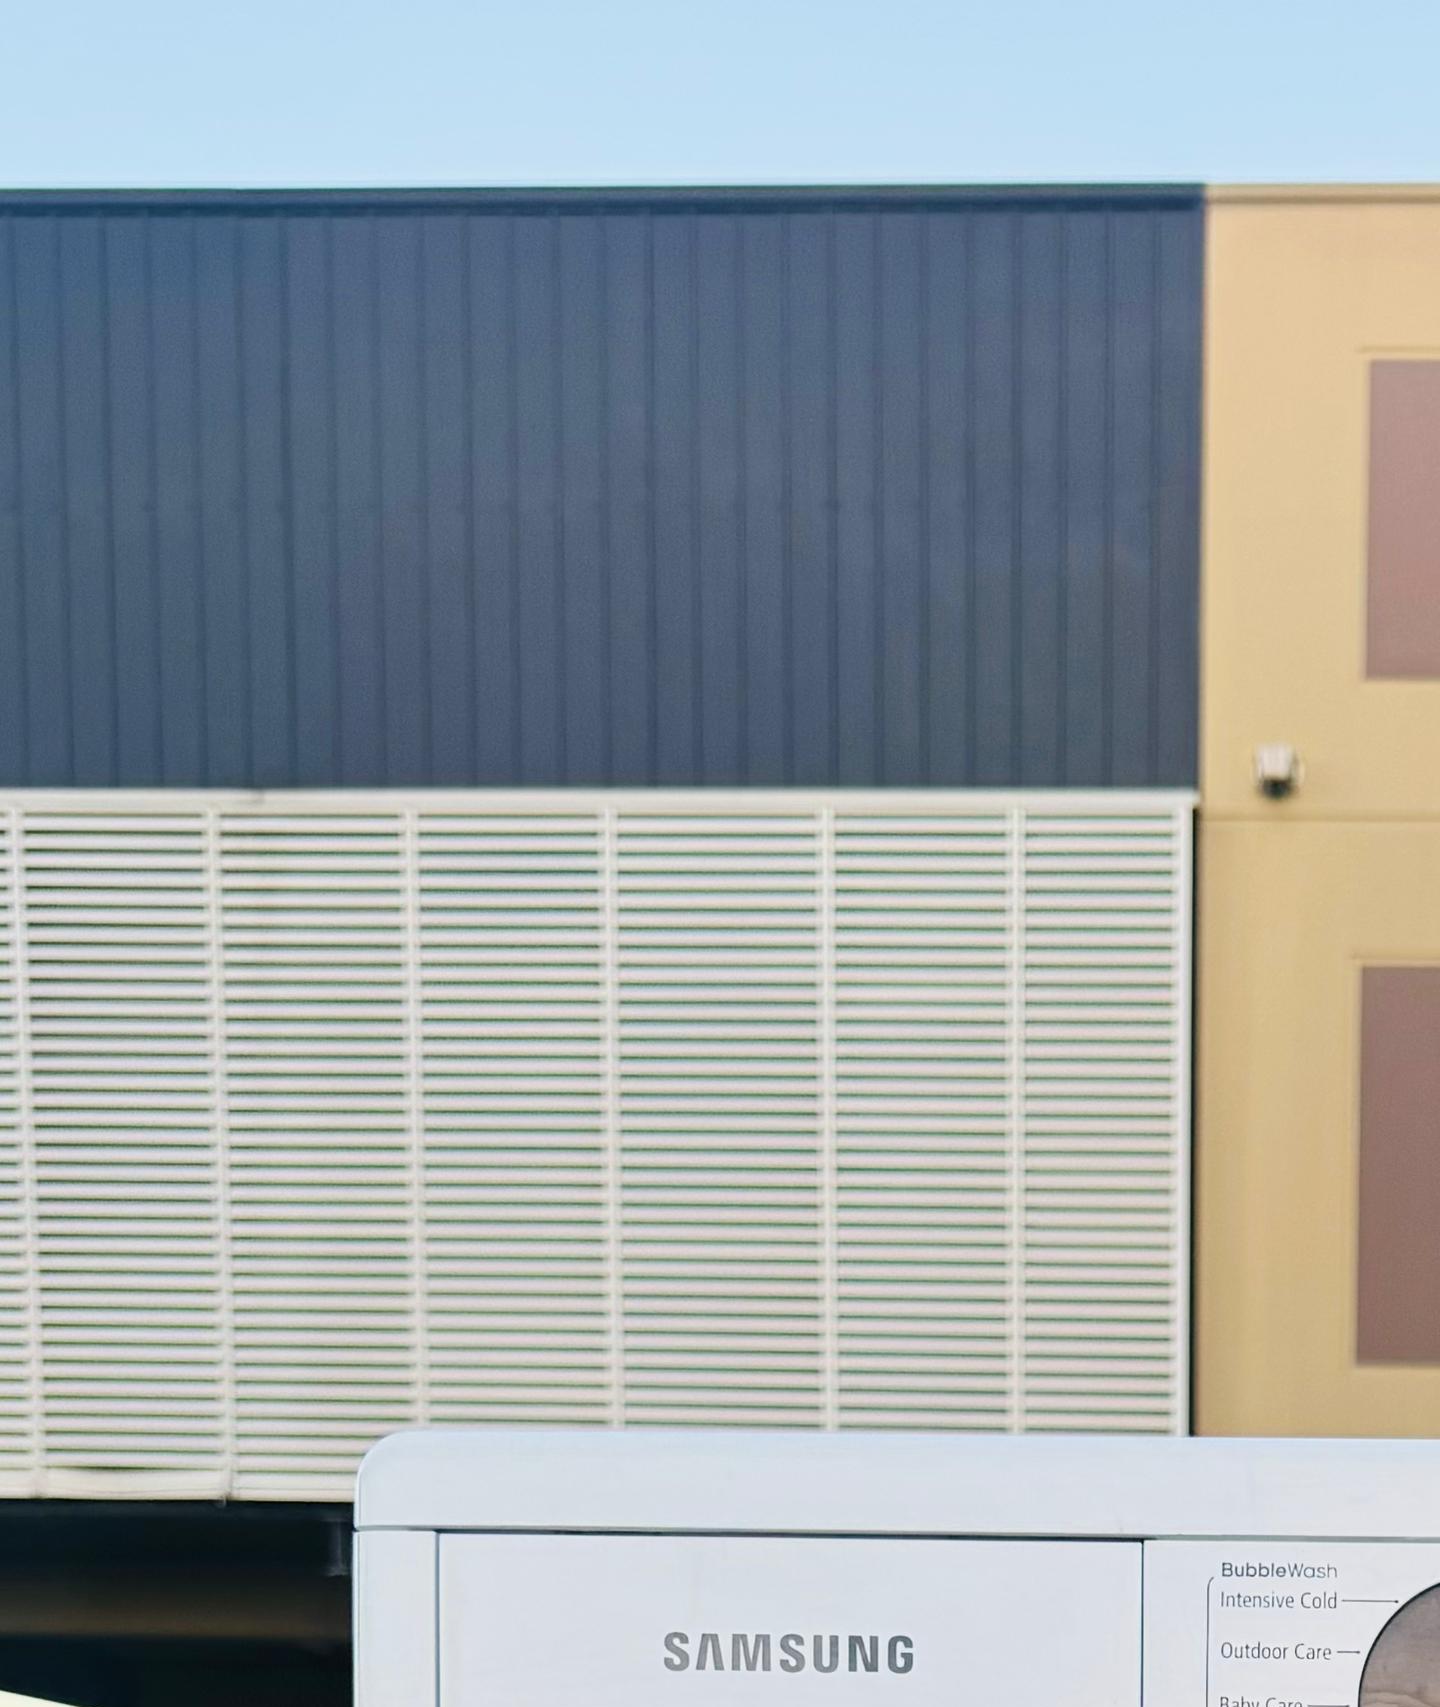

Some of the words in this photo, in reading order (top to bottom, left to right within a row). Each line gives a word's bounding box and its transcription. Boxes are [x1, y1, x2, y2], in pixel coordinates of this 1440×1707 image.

[1221, 1561, 1338, 1579] BubbleWash
[1220, 1591, 1295, 1609] Intensive
[1300, 1591, 1337, 1609] Cold
[663, 1631, 914, 1675] SAMSUNG
[1220, 1641, 1288, 1660] Outdoor
[1294, 1642, 1332, 1661] Care
